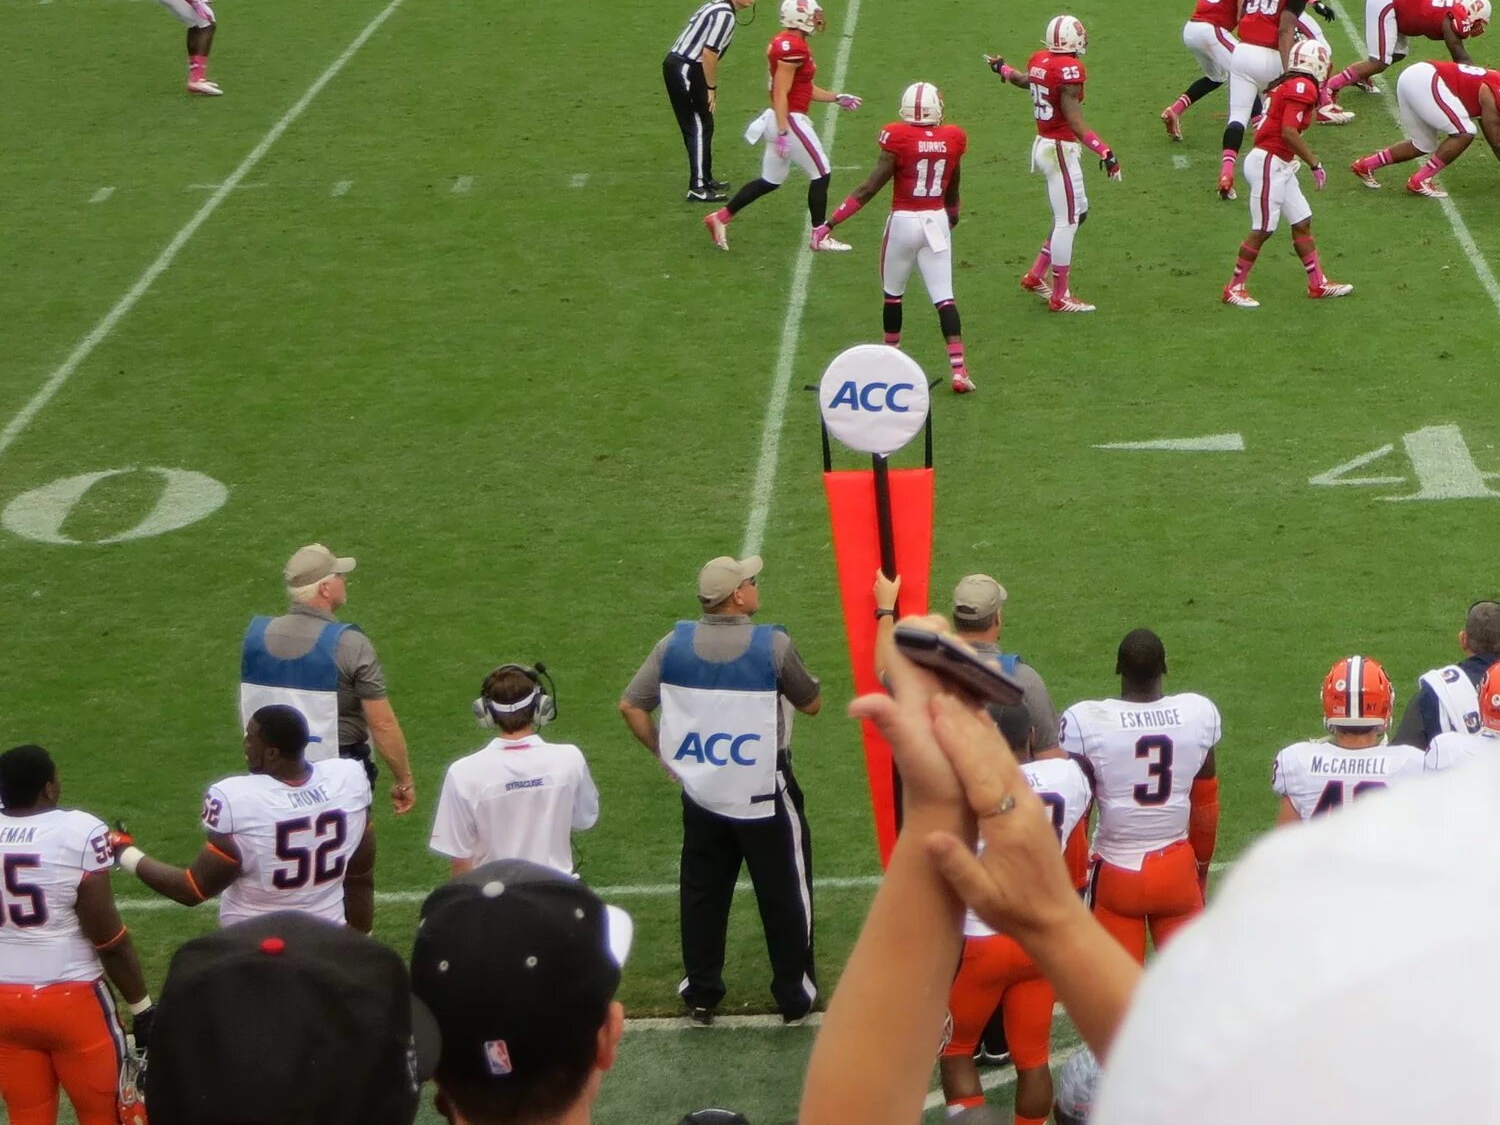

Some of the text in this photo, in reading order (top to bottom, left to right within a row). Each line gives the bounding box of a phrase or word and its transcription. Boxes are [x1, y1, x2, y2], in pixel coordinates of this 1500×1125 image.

[781, 39, 791, 52] 6
[1062, 65, 1080, 80] 25
[1296, 81, 1305, 94] 8
[918, 140, 947, 153] BURRIS
[912, 158, 947, 198] 11
[828, 380, 914, 413] ACC
[1120, 708, 1183, 730] ESKRIDGE
[673, 732, 762, 767] ACC
[1132, 734, 1174, 807] 3
[1310, 755, 1386, 775] McCARRELL
[505, 776, 544, 792] SYRACUSE
[287, 784, 330, 809] CROME
[271, 809, 348, 891] 52
[0, 852, 50, 928] 5
